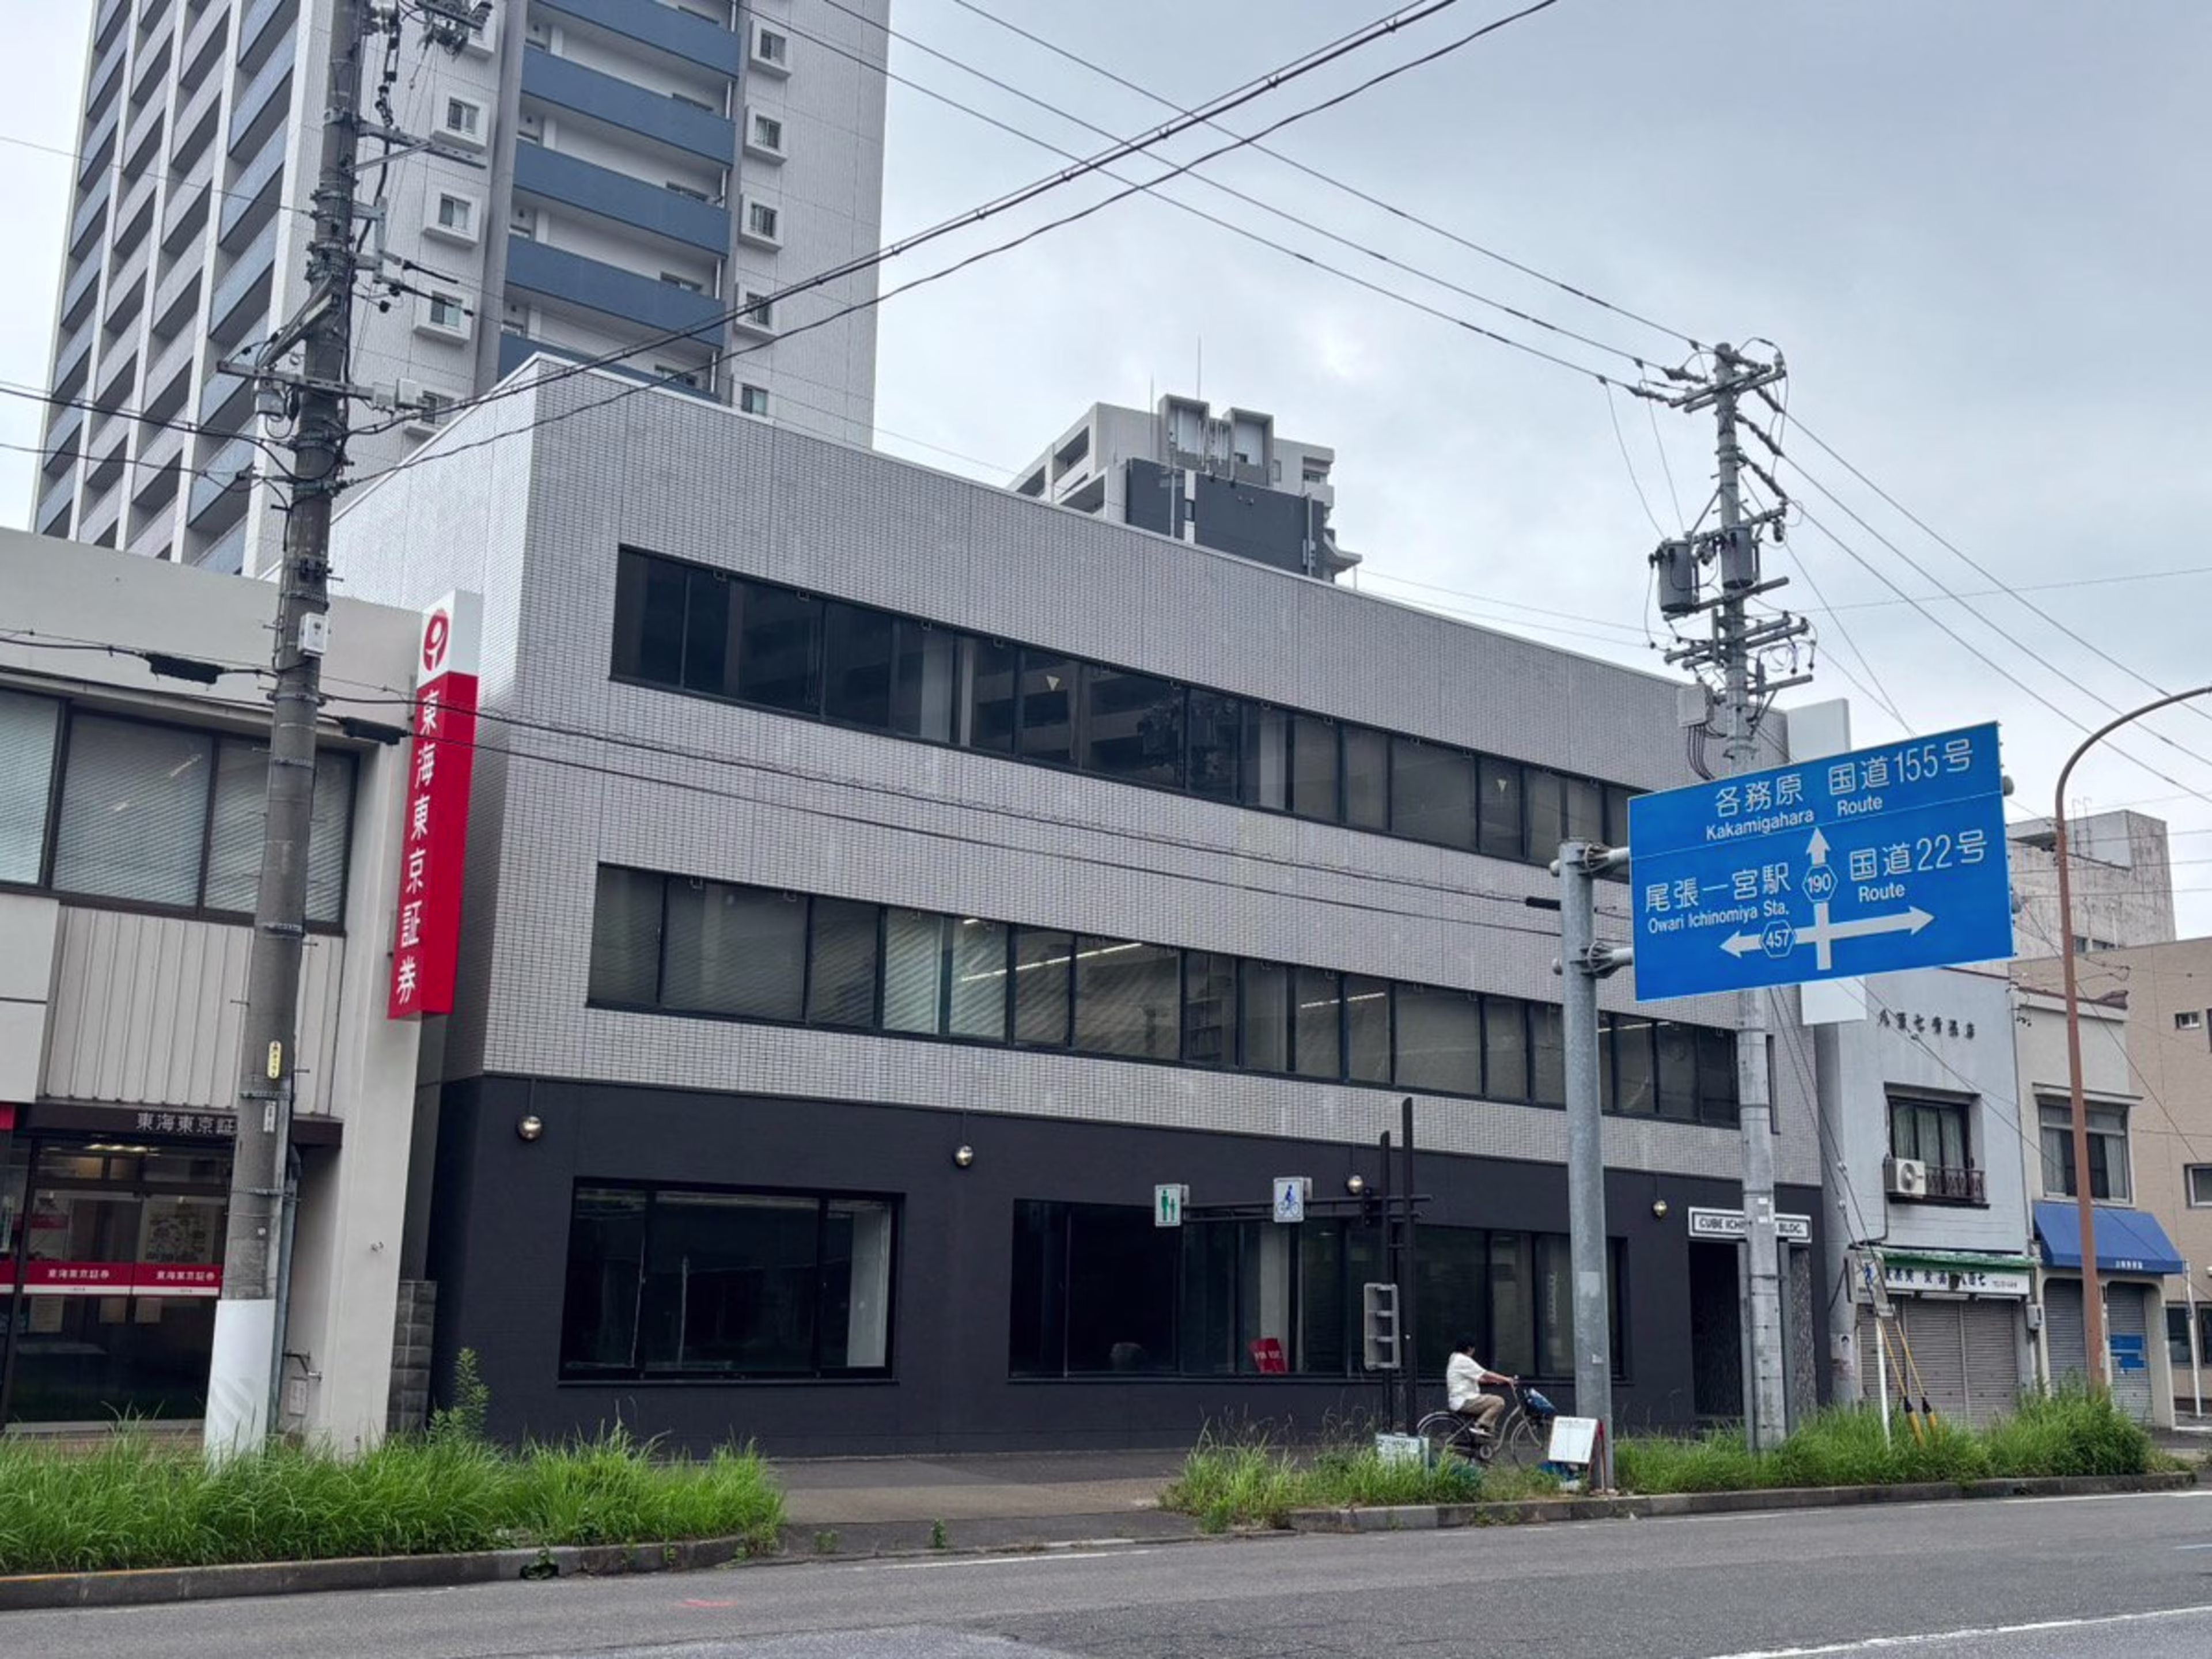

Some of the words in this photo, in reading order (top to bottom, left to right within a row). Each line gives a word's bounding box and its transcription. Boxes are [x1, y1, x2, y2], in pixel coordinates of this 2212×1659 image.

[1714, 773, 1804, 818] 各務原
[1828, 738, 1973, 796] 国道155号
[1706, 809, 1815, 841] Kakamigahara
[1837, 794, 1883, 817] Route
[397, 690, 440, 1005] 東海東京証券
[1645, 862, 1791, 914] 尾張一宮駅
[1850, 828, 1987, 882] 国道22号
[1806, 873, 1832, 893] 190
[1858, 882, 1906, 903] Route
[1648, 915, 1684, 933] Owari
[1688, 904, 1758, 929] Ichinomiya
[1763, 901, 1790, 916] Sta.
[1766, 929, 1790, 948] 457
[136, 1112, 237, 1135] 東海東京証
